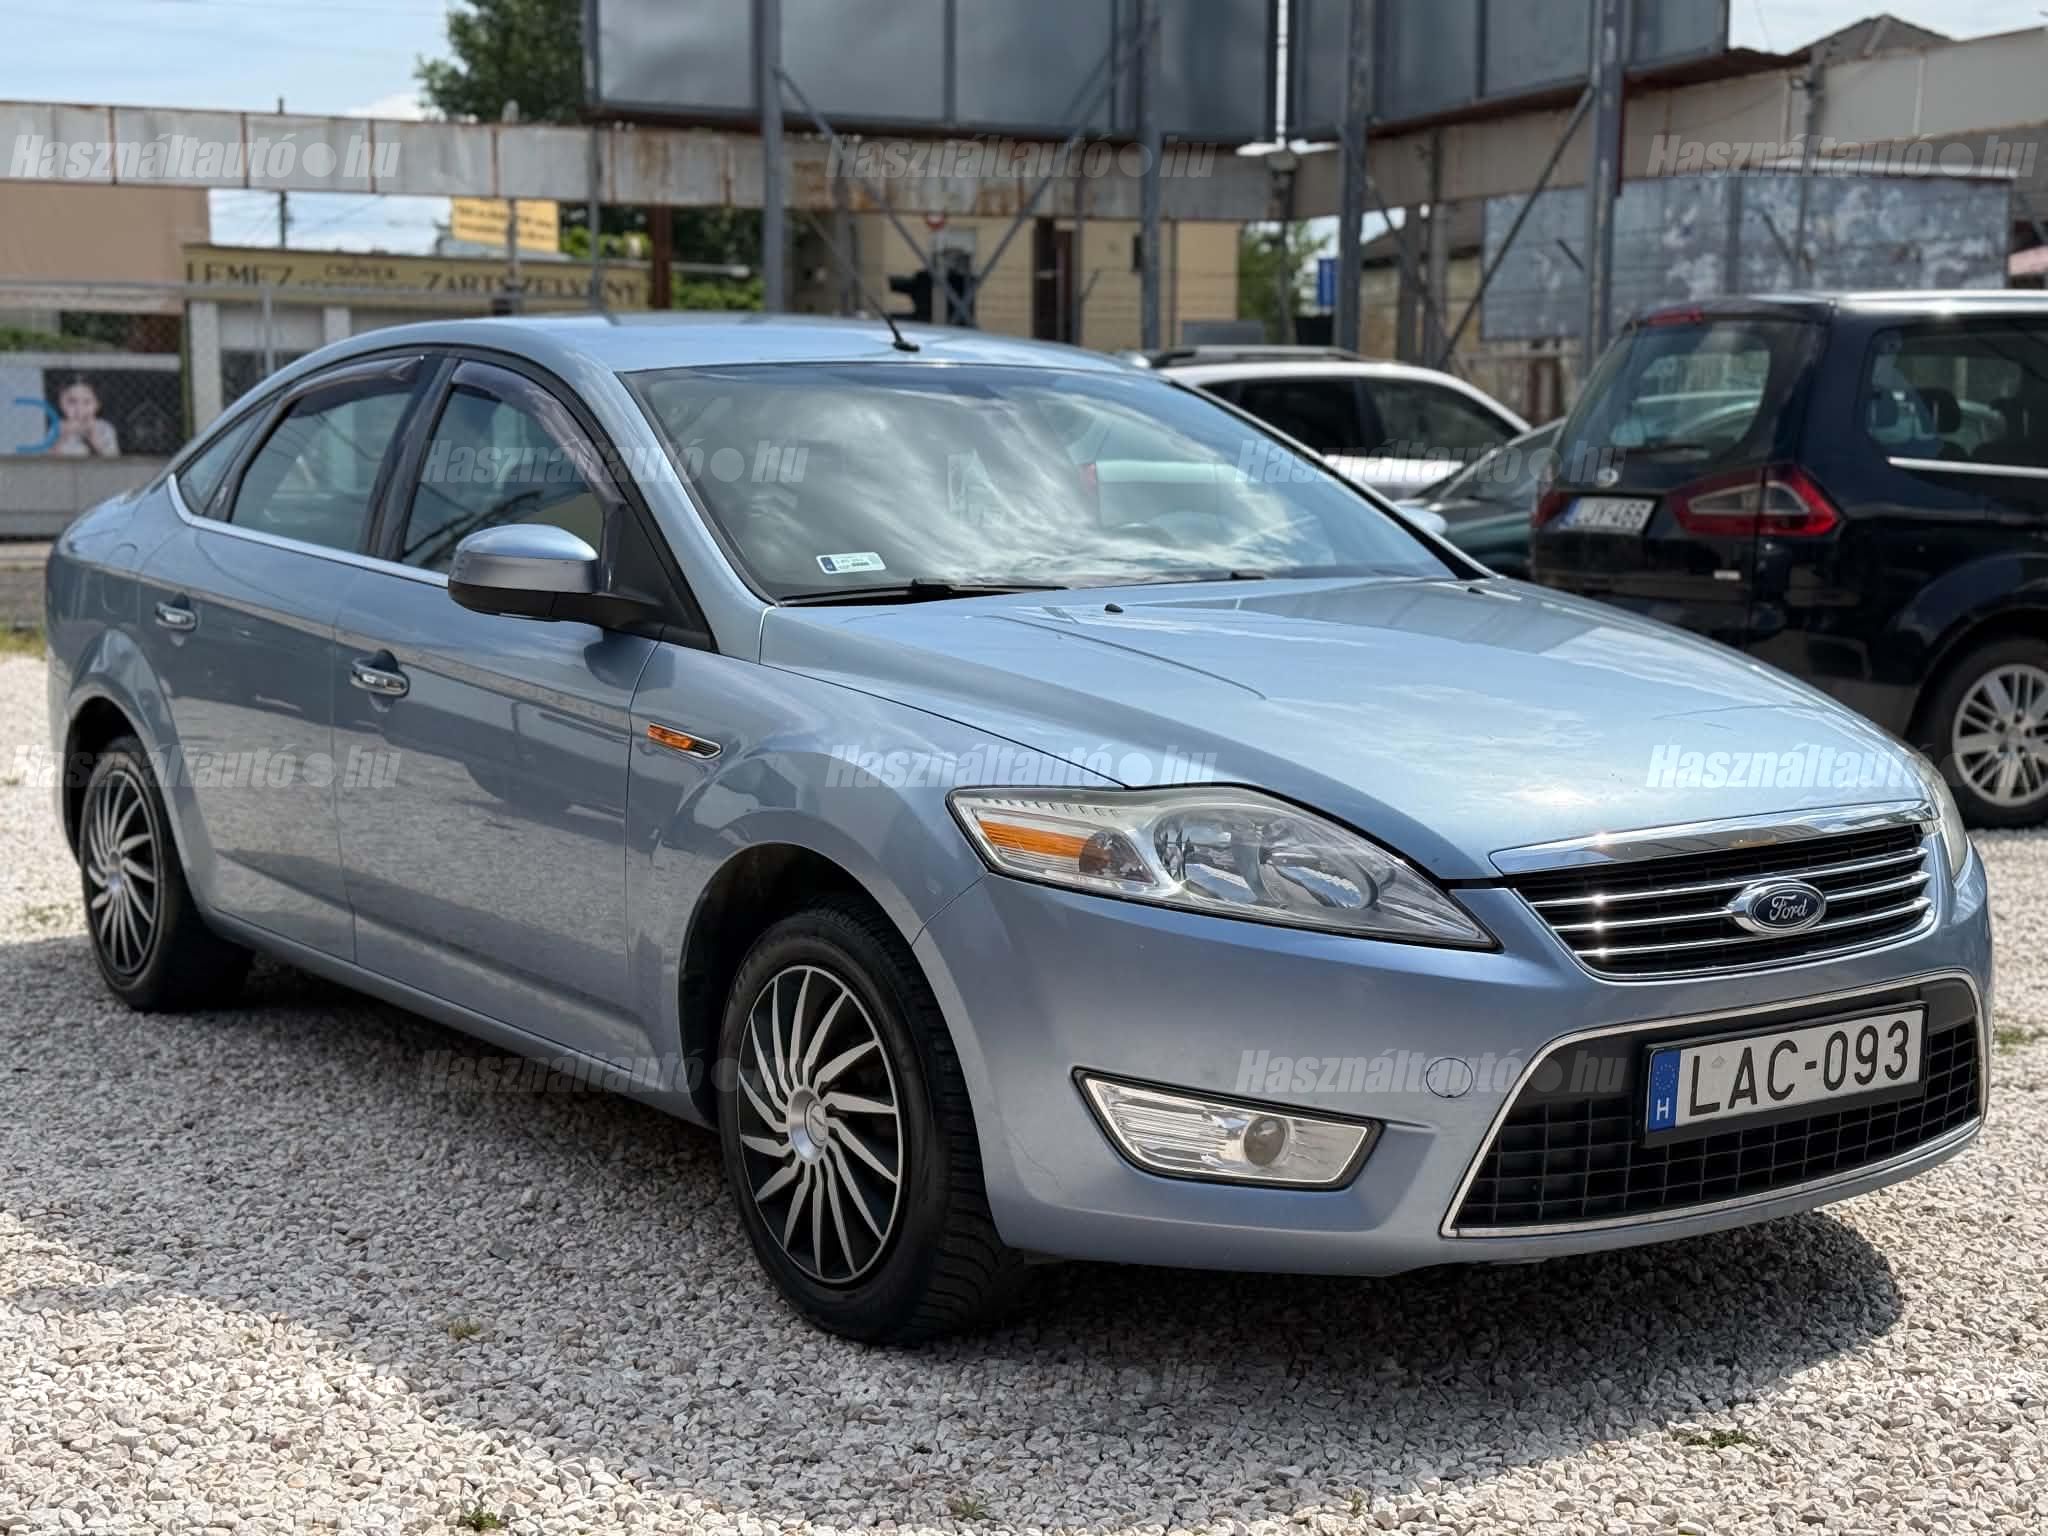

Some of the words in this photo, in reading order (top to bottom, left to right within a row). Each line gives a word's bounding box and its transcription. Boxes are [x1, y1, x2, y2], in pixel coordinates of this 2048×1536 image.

[1769, 894, 1808, 920] Ford
[1689, 1019, 1910, 1116] LAC-093
[1656, 1097, 1670, 1121] H
